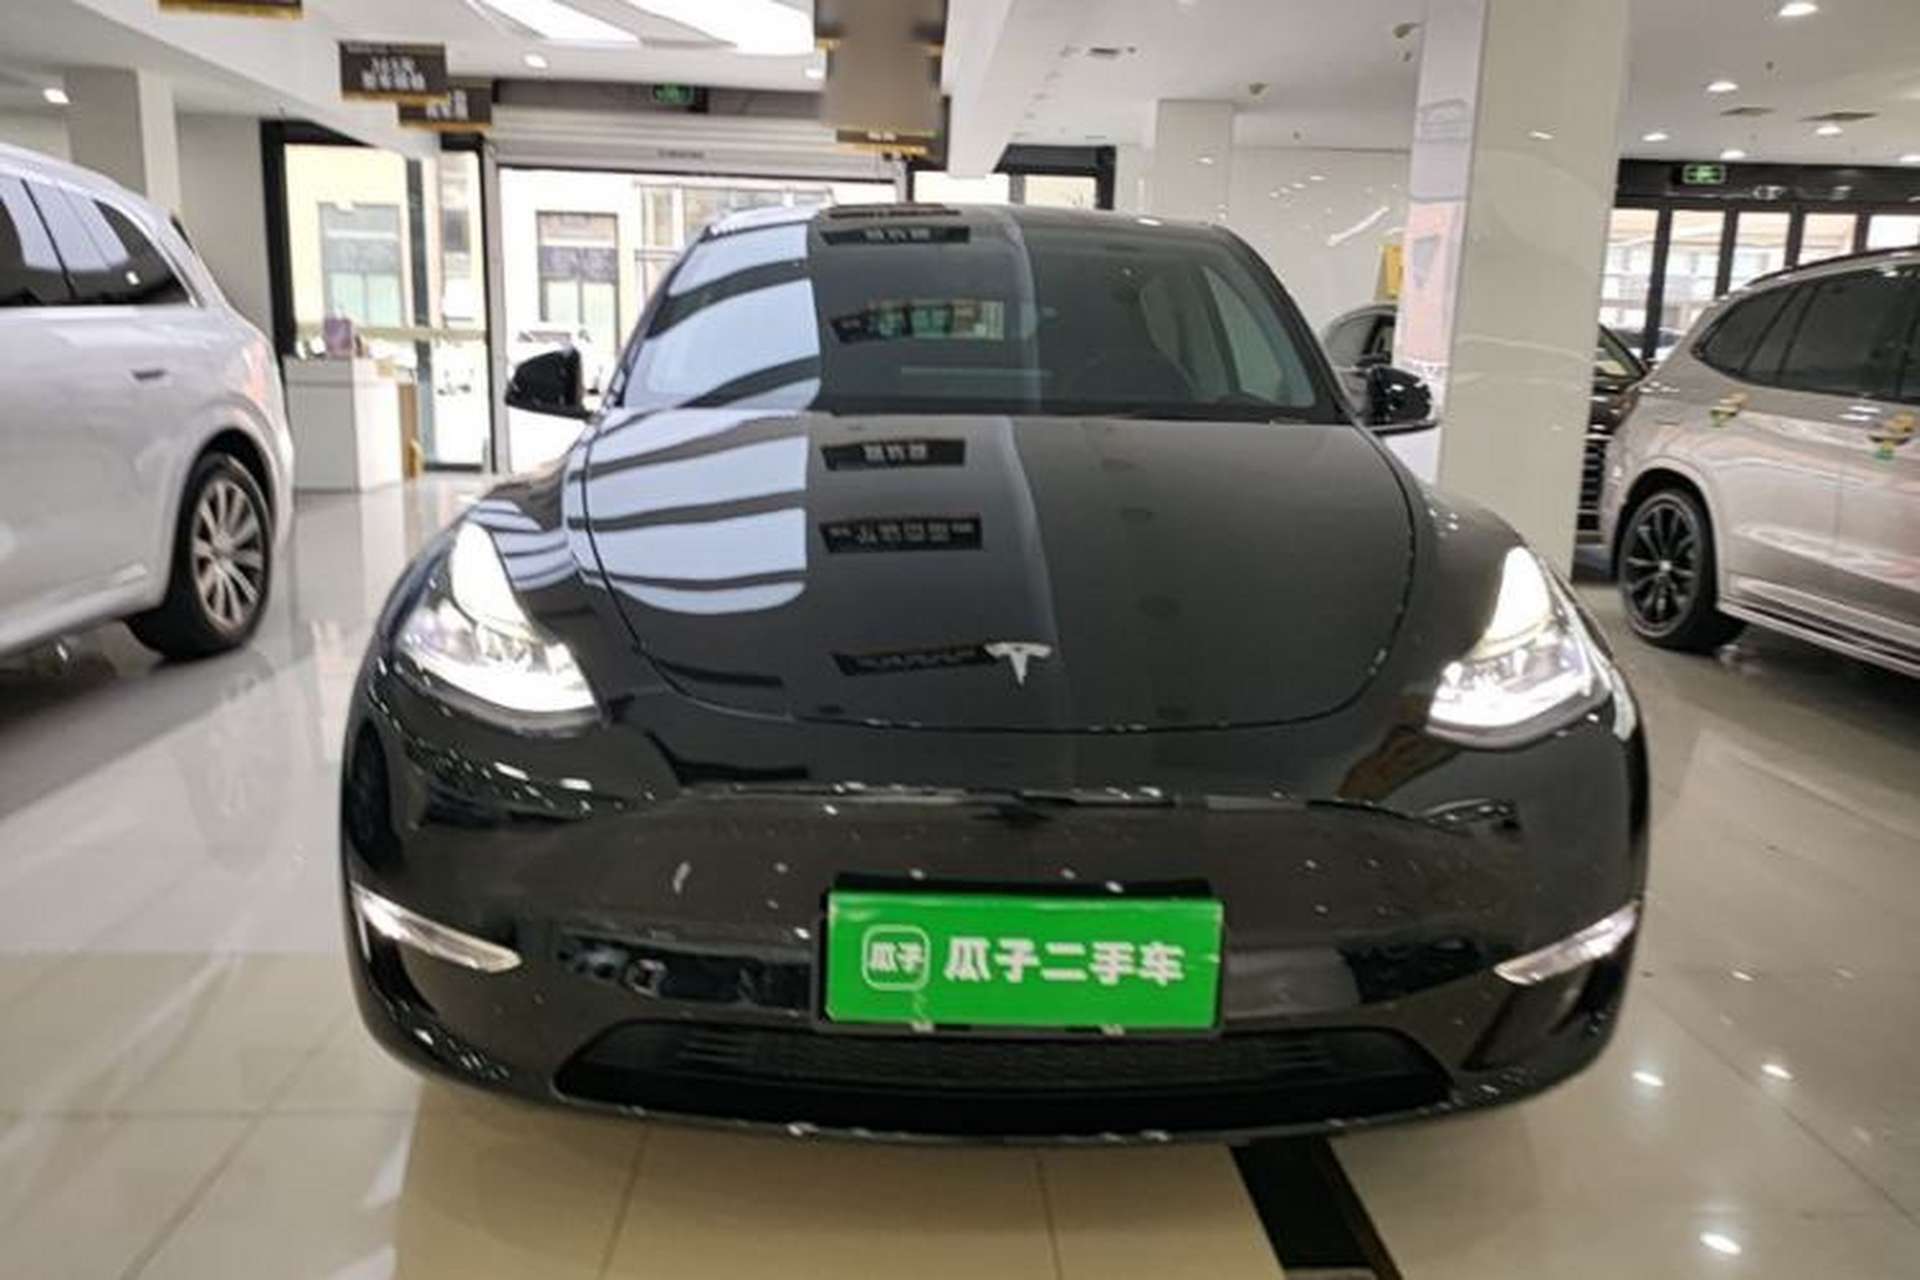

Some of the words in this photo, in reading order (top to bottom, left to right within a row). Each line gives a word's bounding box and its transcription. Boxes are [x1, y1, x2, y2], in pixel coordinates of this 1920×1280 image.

[868, 941, 924, 974] 瓜子
[943, 936, 1185, 986] 瓜子二手车
